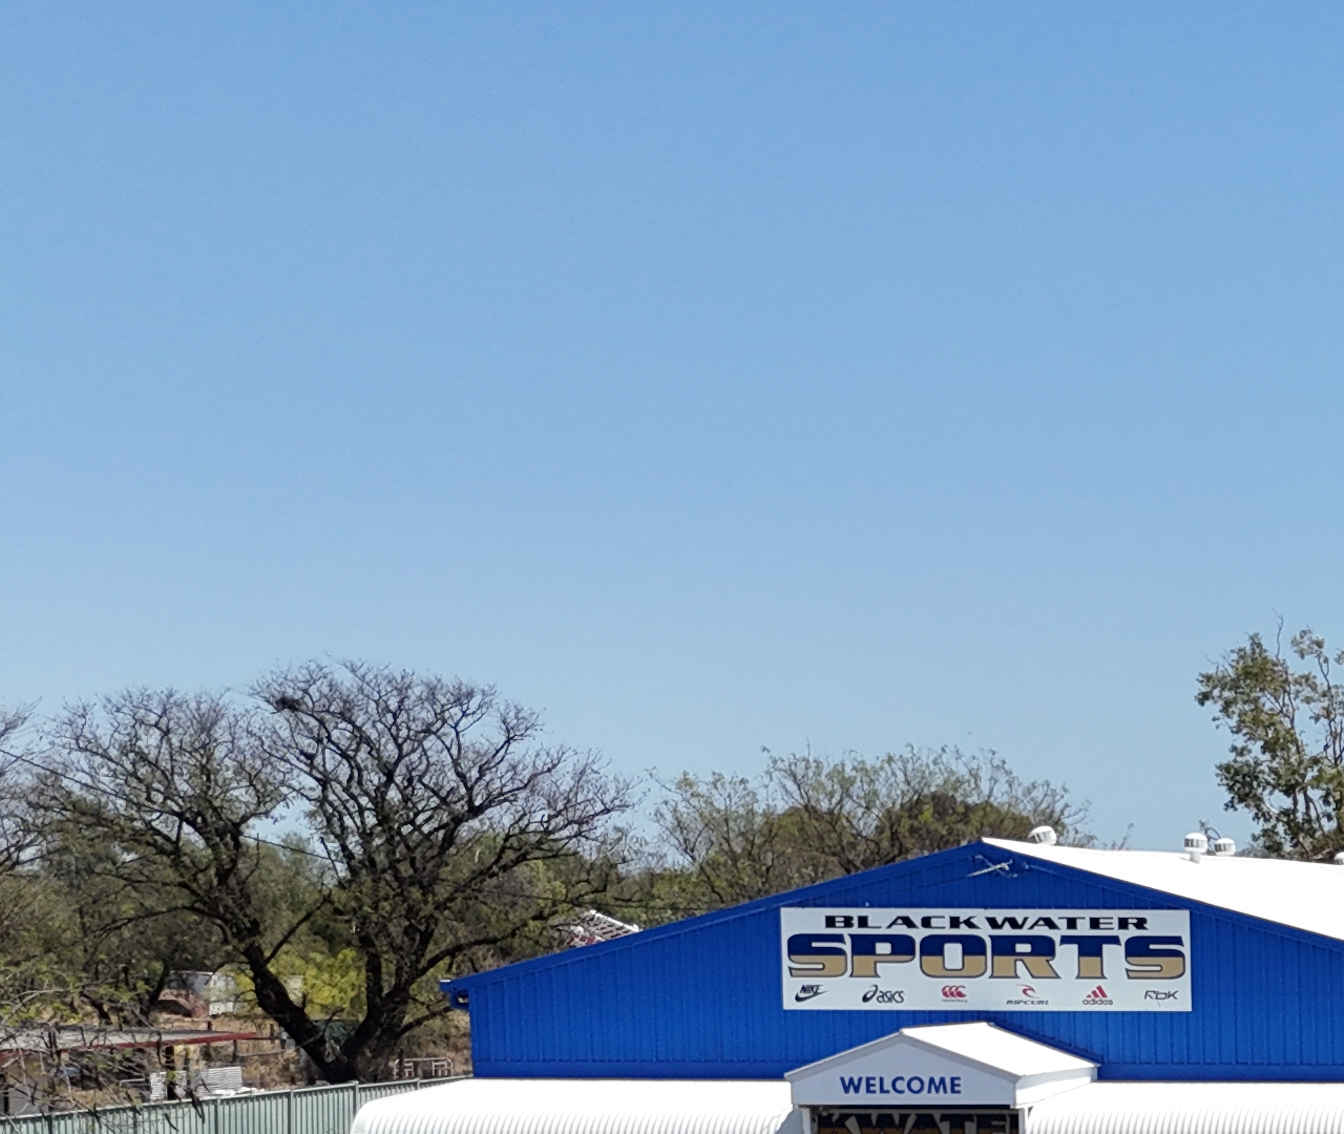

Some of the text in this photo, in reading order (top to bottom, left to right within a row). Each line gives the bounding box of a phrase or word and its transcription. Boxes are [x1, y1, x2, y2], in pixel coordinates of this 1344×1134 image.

[824, 915, 1150, 931] BLACKWATER
[787, 933, 1187, 981] SPORTS
[1082, 998, 1114, 1006] adidas
[840, 1075, 963, 1095] WELCOME
